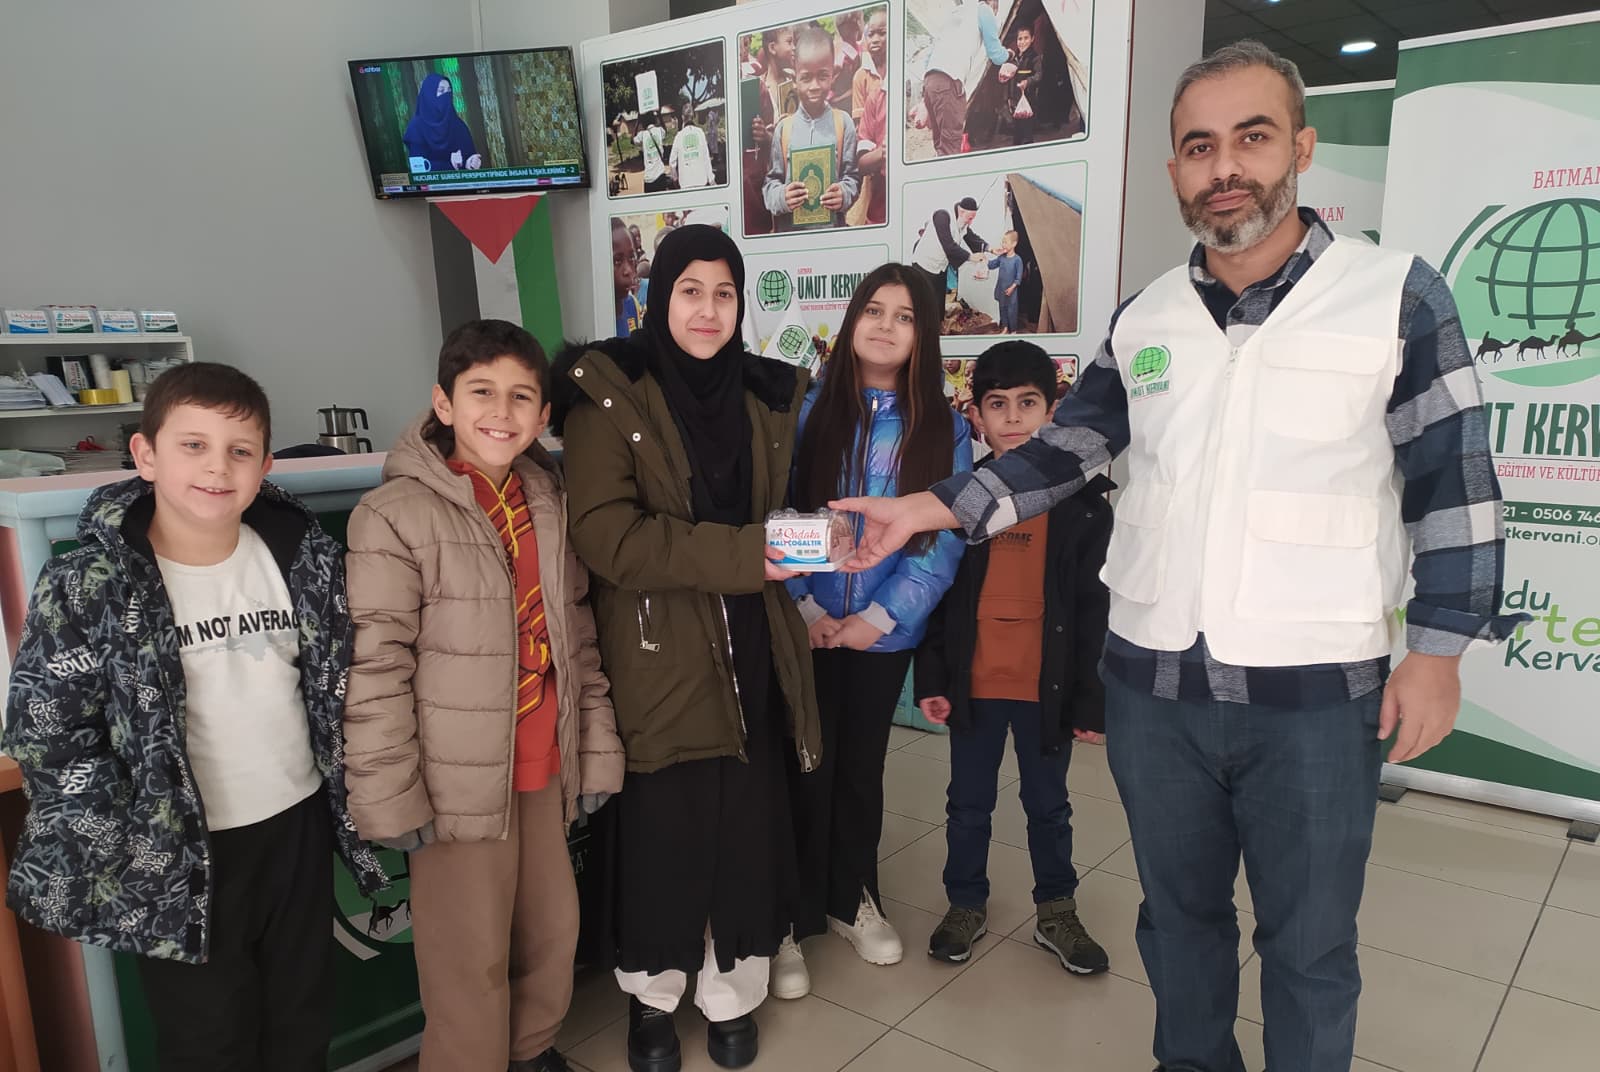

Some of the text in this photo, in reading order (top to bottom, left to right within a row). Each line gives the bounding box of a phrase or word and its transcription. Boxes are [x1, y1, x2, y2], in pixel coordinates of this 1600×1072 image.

[797, 275, 827, 300] UMUT
[1497, 462, 1536, 478] EĞİTİM
[1540, 466, 1554, 479] VE
[1532, 508, 1572, 521] 0506
[196, 616, 231, 642] NOT
